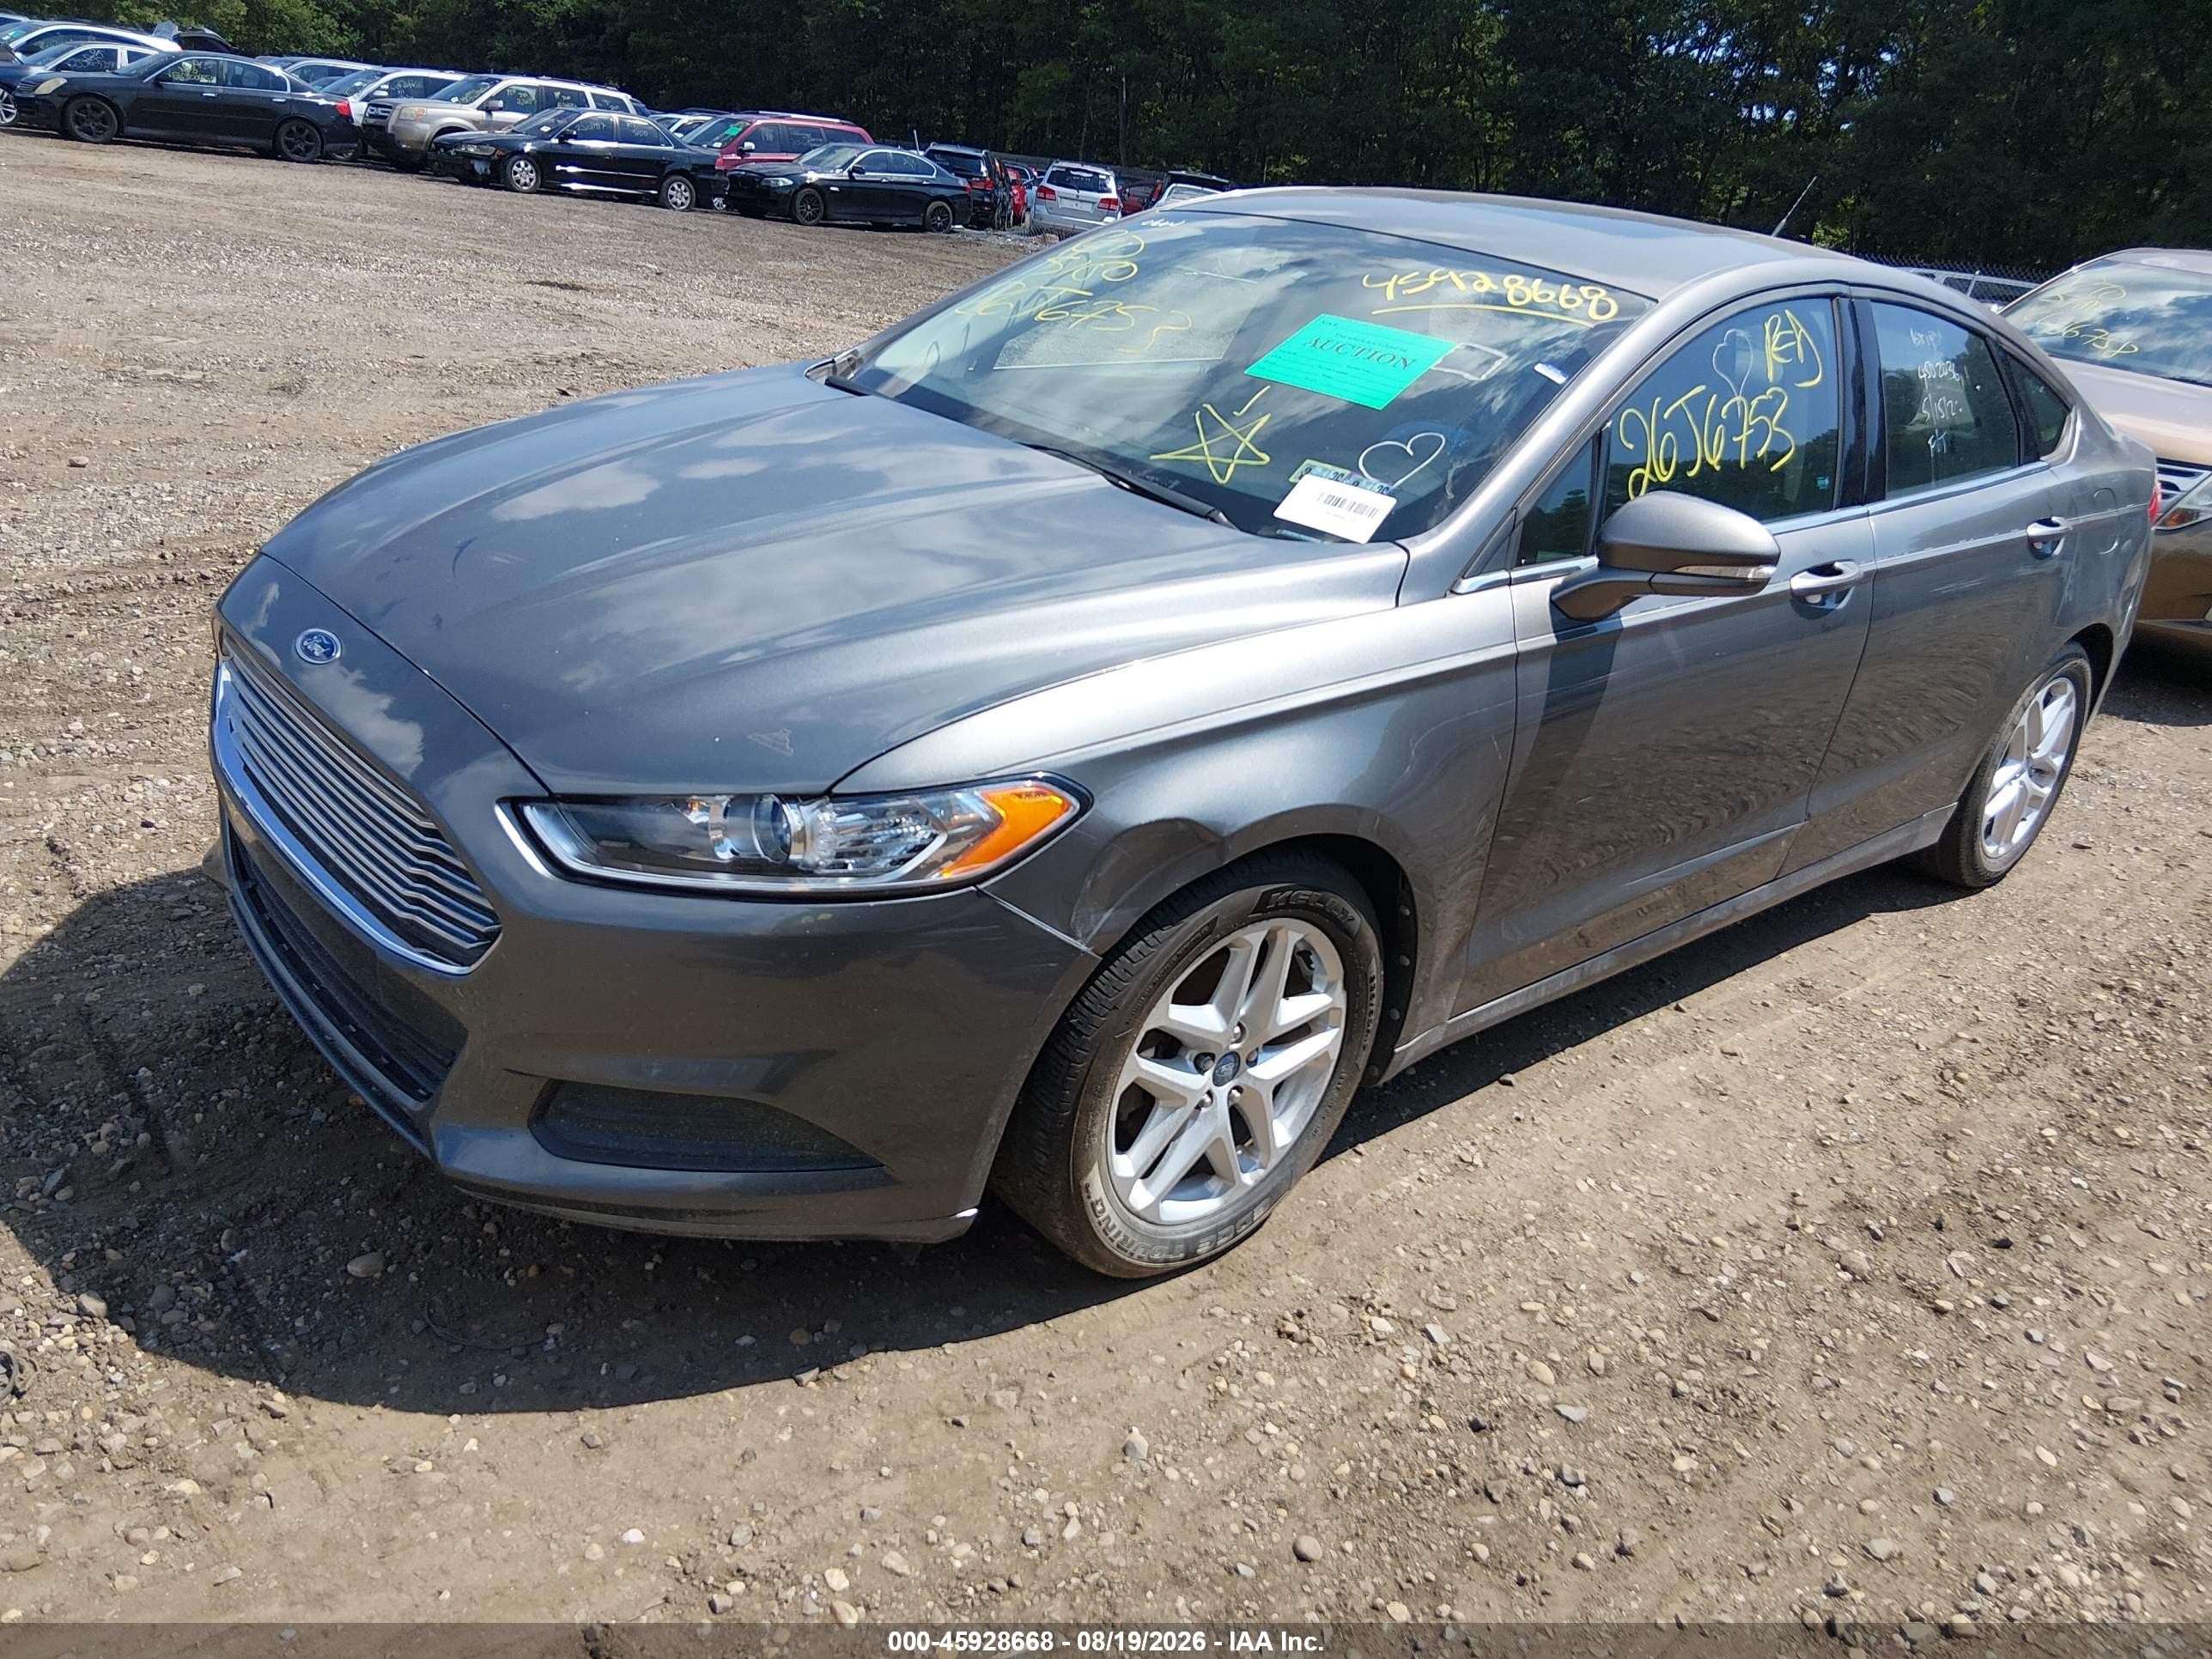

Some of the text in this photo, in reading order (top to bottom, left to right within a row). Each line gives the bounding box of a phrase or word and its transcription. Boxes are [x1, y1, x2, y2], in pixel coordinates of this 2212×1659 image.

[1363, 267, 1619, 321] 45928668
[1304, 336, 1416, 371] AUCTION
[1620, 385, 1797, 501] 26J6753
[1266, 890, 1356, 924] KELLY
[1090, 1198, 1186, 1261] TOURING
